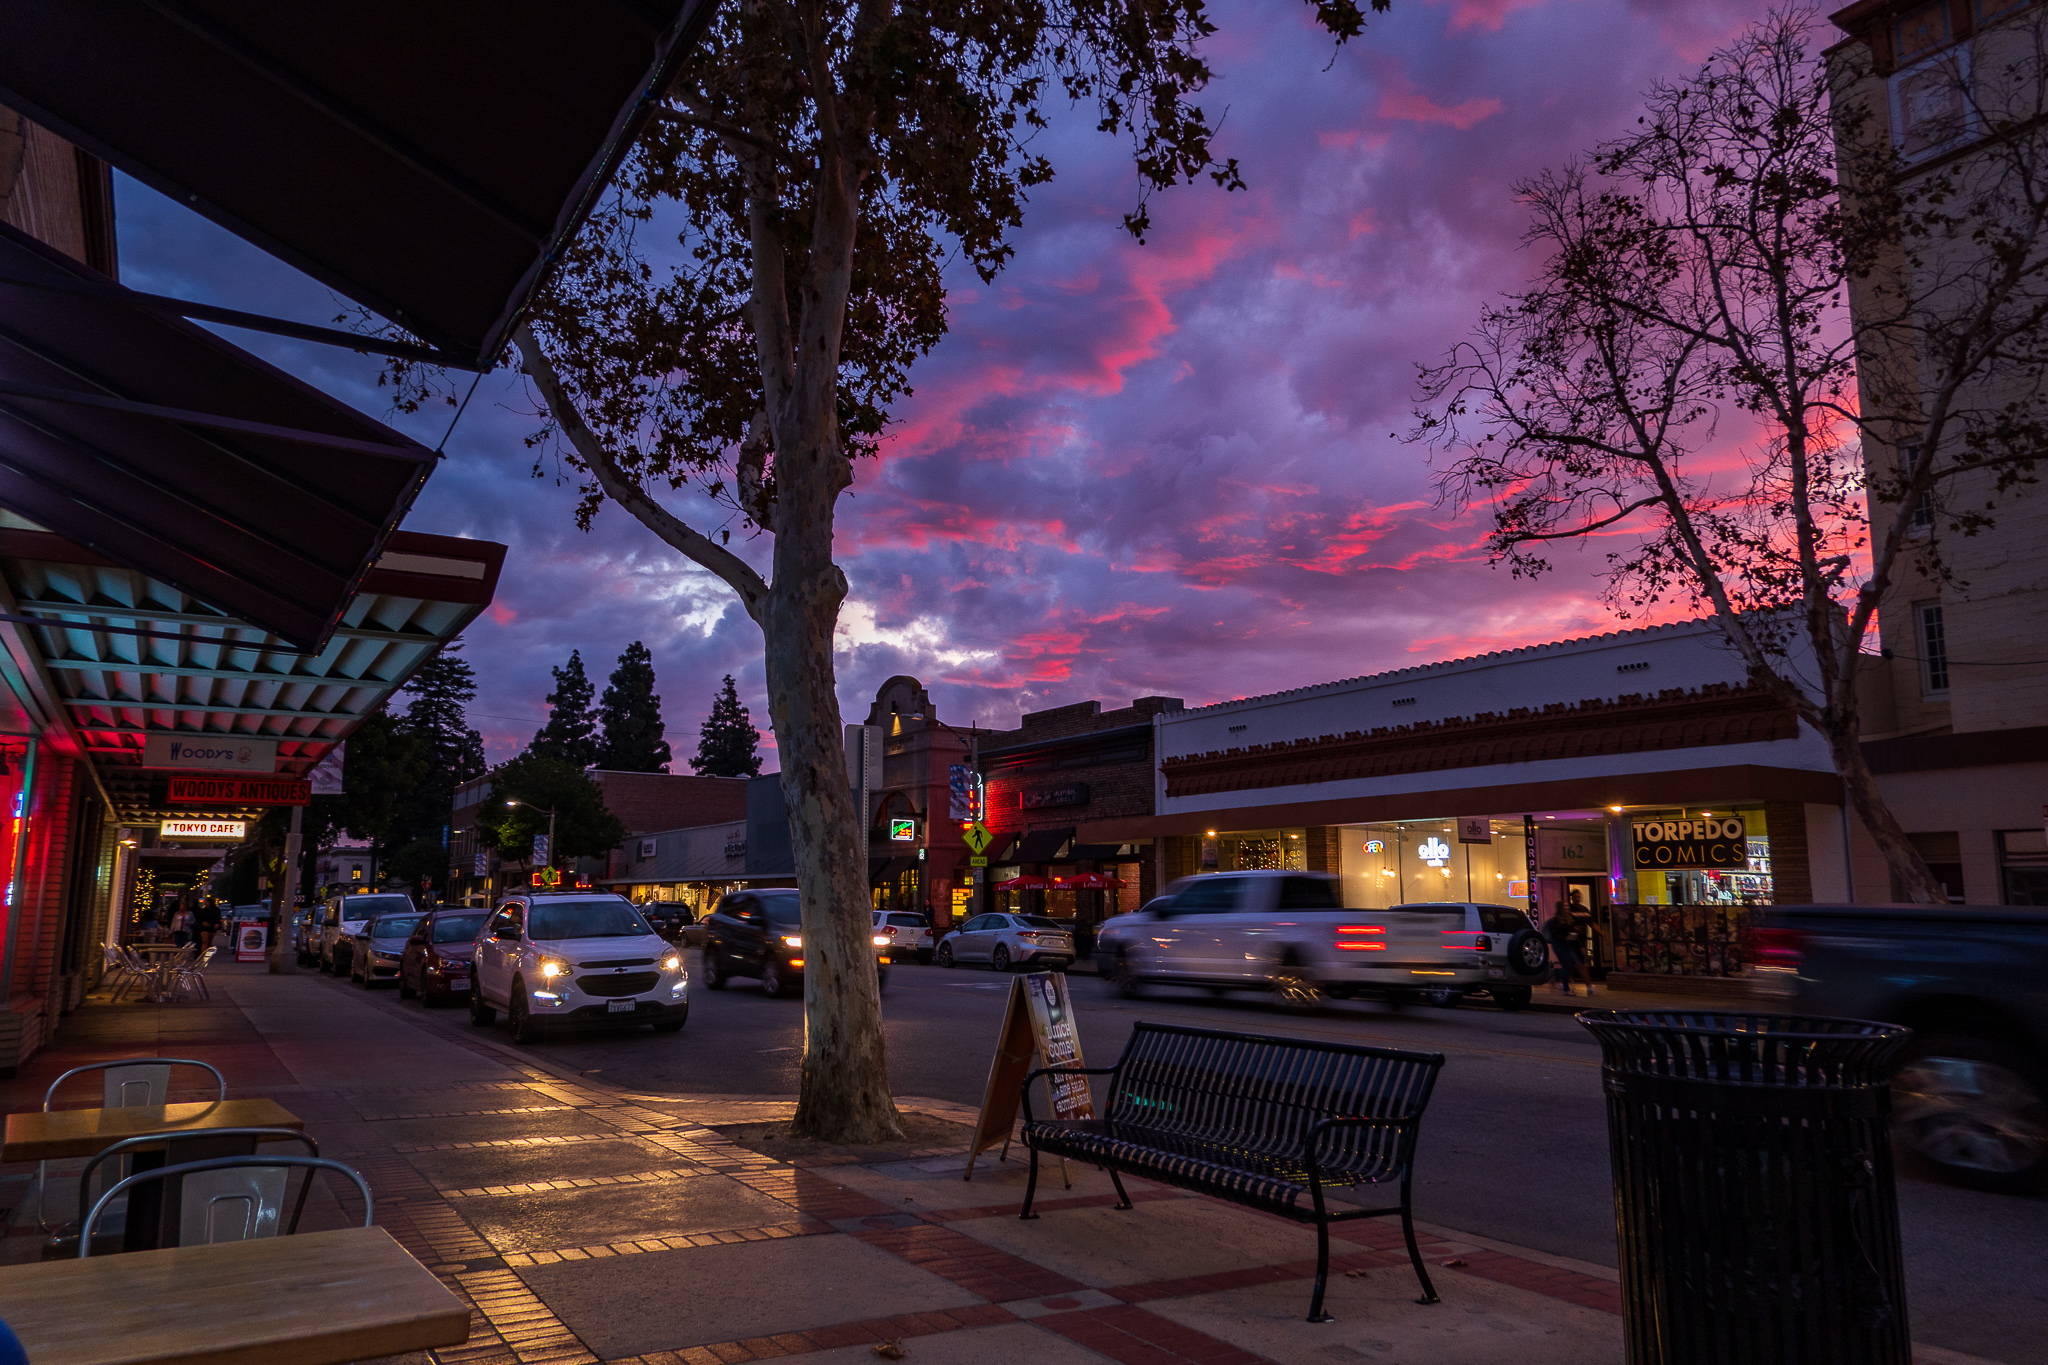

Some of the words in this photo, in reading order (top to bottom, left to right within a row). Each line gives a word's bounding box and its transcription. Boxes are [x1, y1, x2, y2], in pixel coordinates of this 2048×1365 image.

[171, 742, 233, 760] WOODY'S
[173, 780, 234, 798] WOODYS
[239, 783, 306, 800] ANTIQUES
[173, 823, 207, 832] TOKYO
[210, 824, 234, 833] CAFE
[1633, 819, 1742, 842] TORPEDO
[1363, 842, 1383, 853] OPEN
[1562, 845, 1584, 859] 162
[1636, 844, 1744, 864] COMICS
[972, 857, 986, 865] AHEAD
[1527, 826, 1538, 903] TORPEDO
[1046, 1023, 1071, 1039] LUNCH
[1048, 1040, 1076, 1057] COMBO
